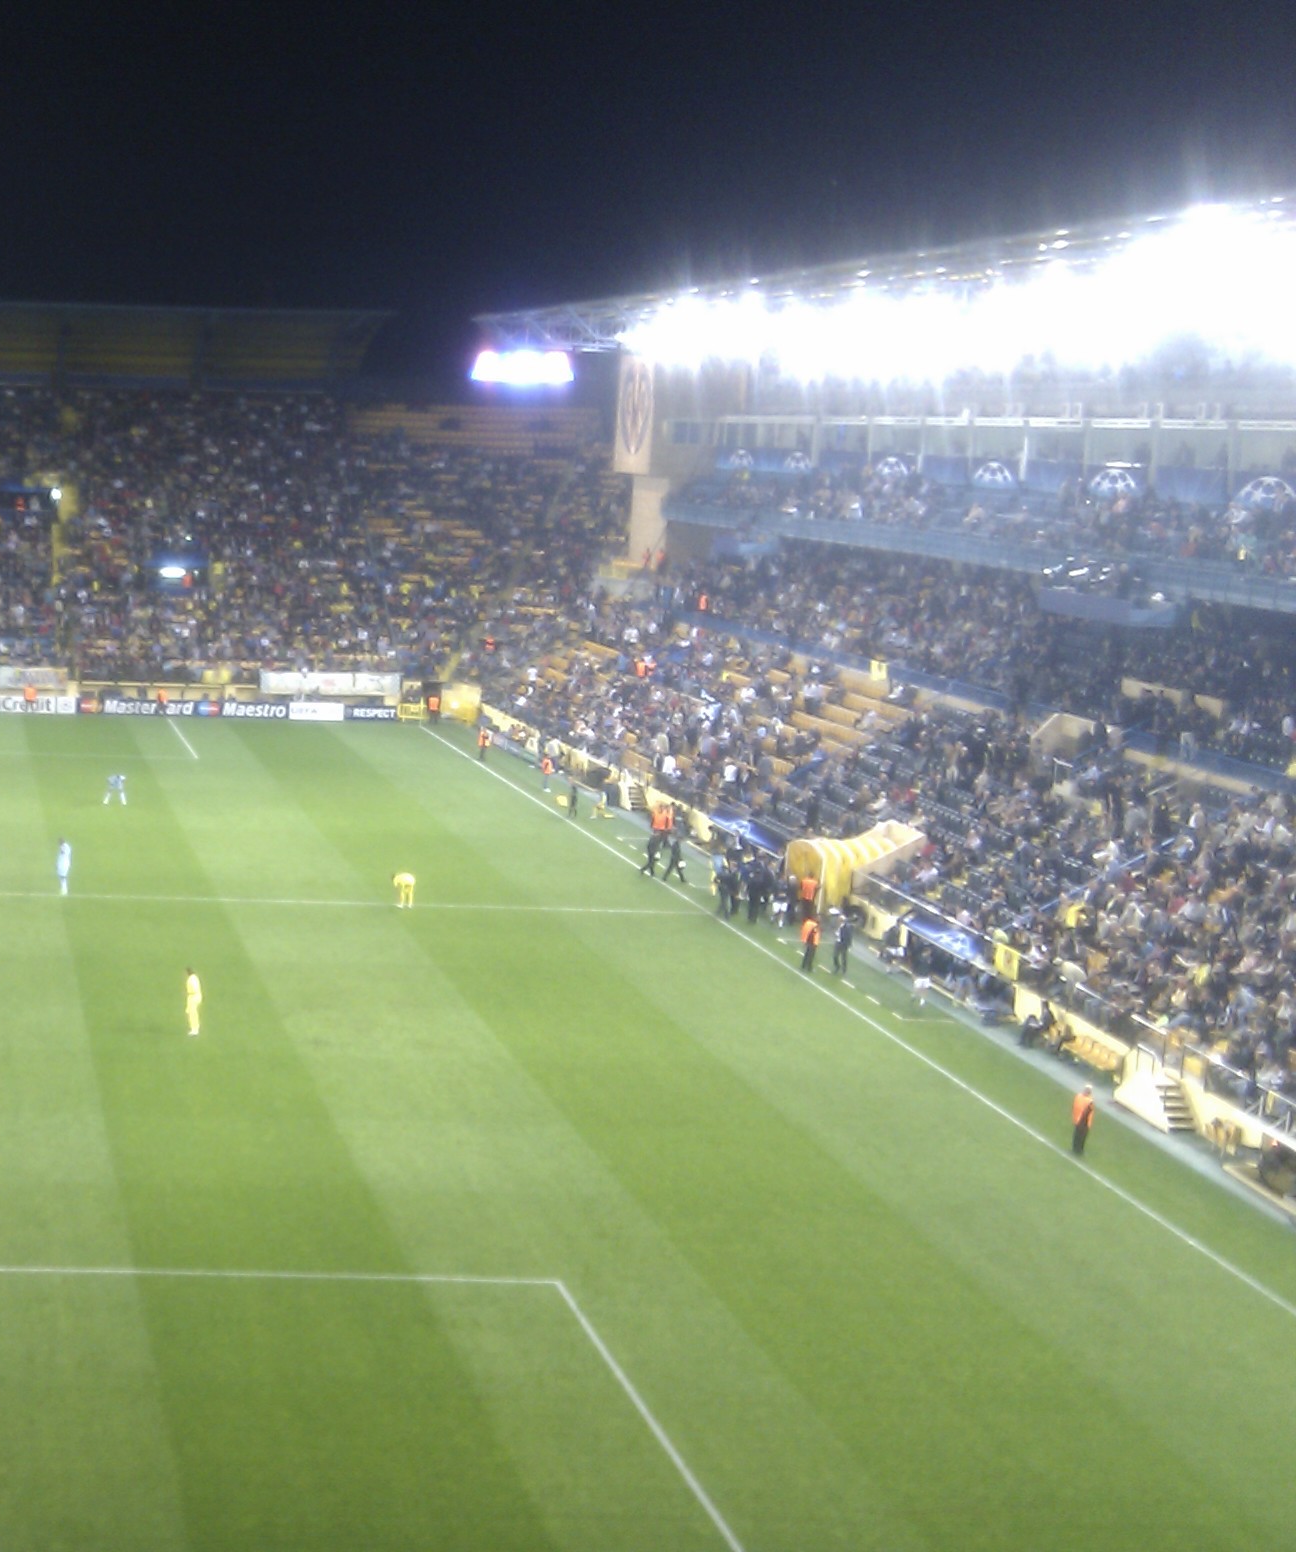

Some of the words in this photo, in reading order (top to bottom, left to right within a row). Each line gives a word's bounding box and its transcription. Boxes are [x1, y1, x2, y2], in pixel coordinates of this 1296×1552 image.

[104, 701, 194, 715] Masterard
[222, 702, 287, 718] Maestro
[353, 707, 397, 719] RESPECT
